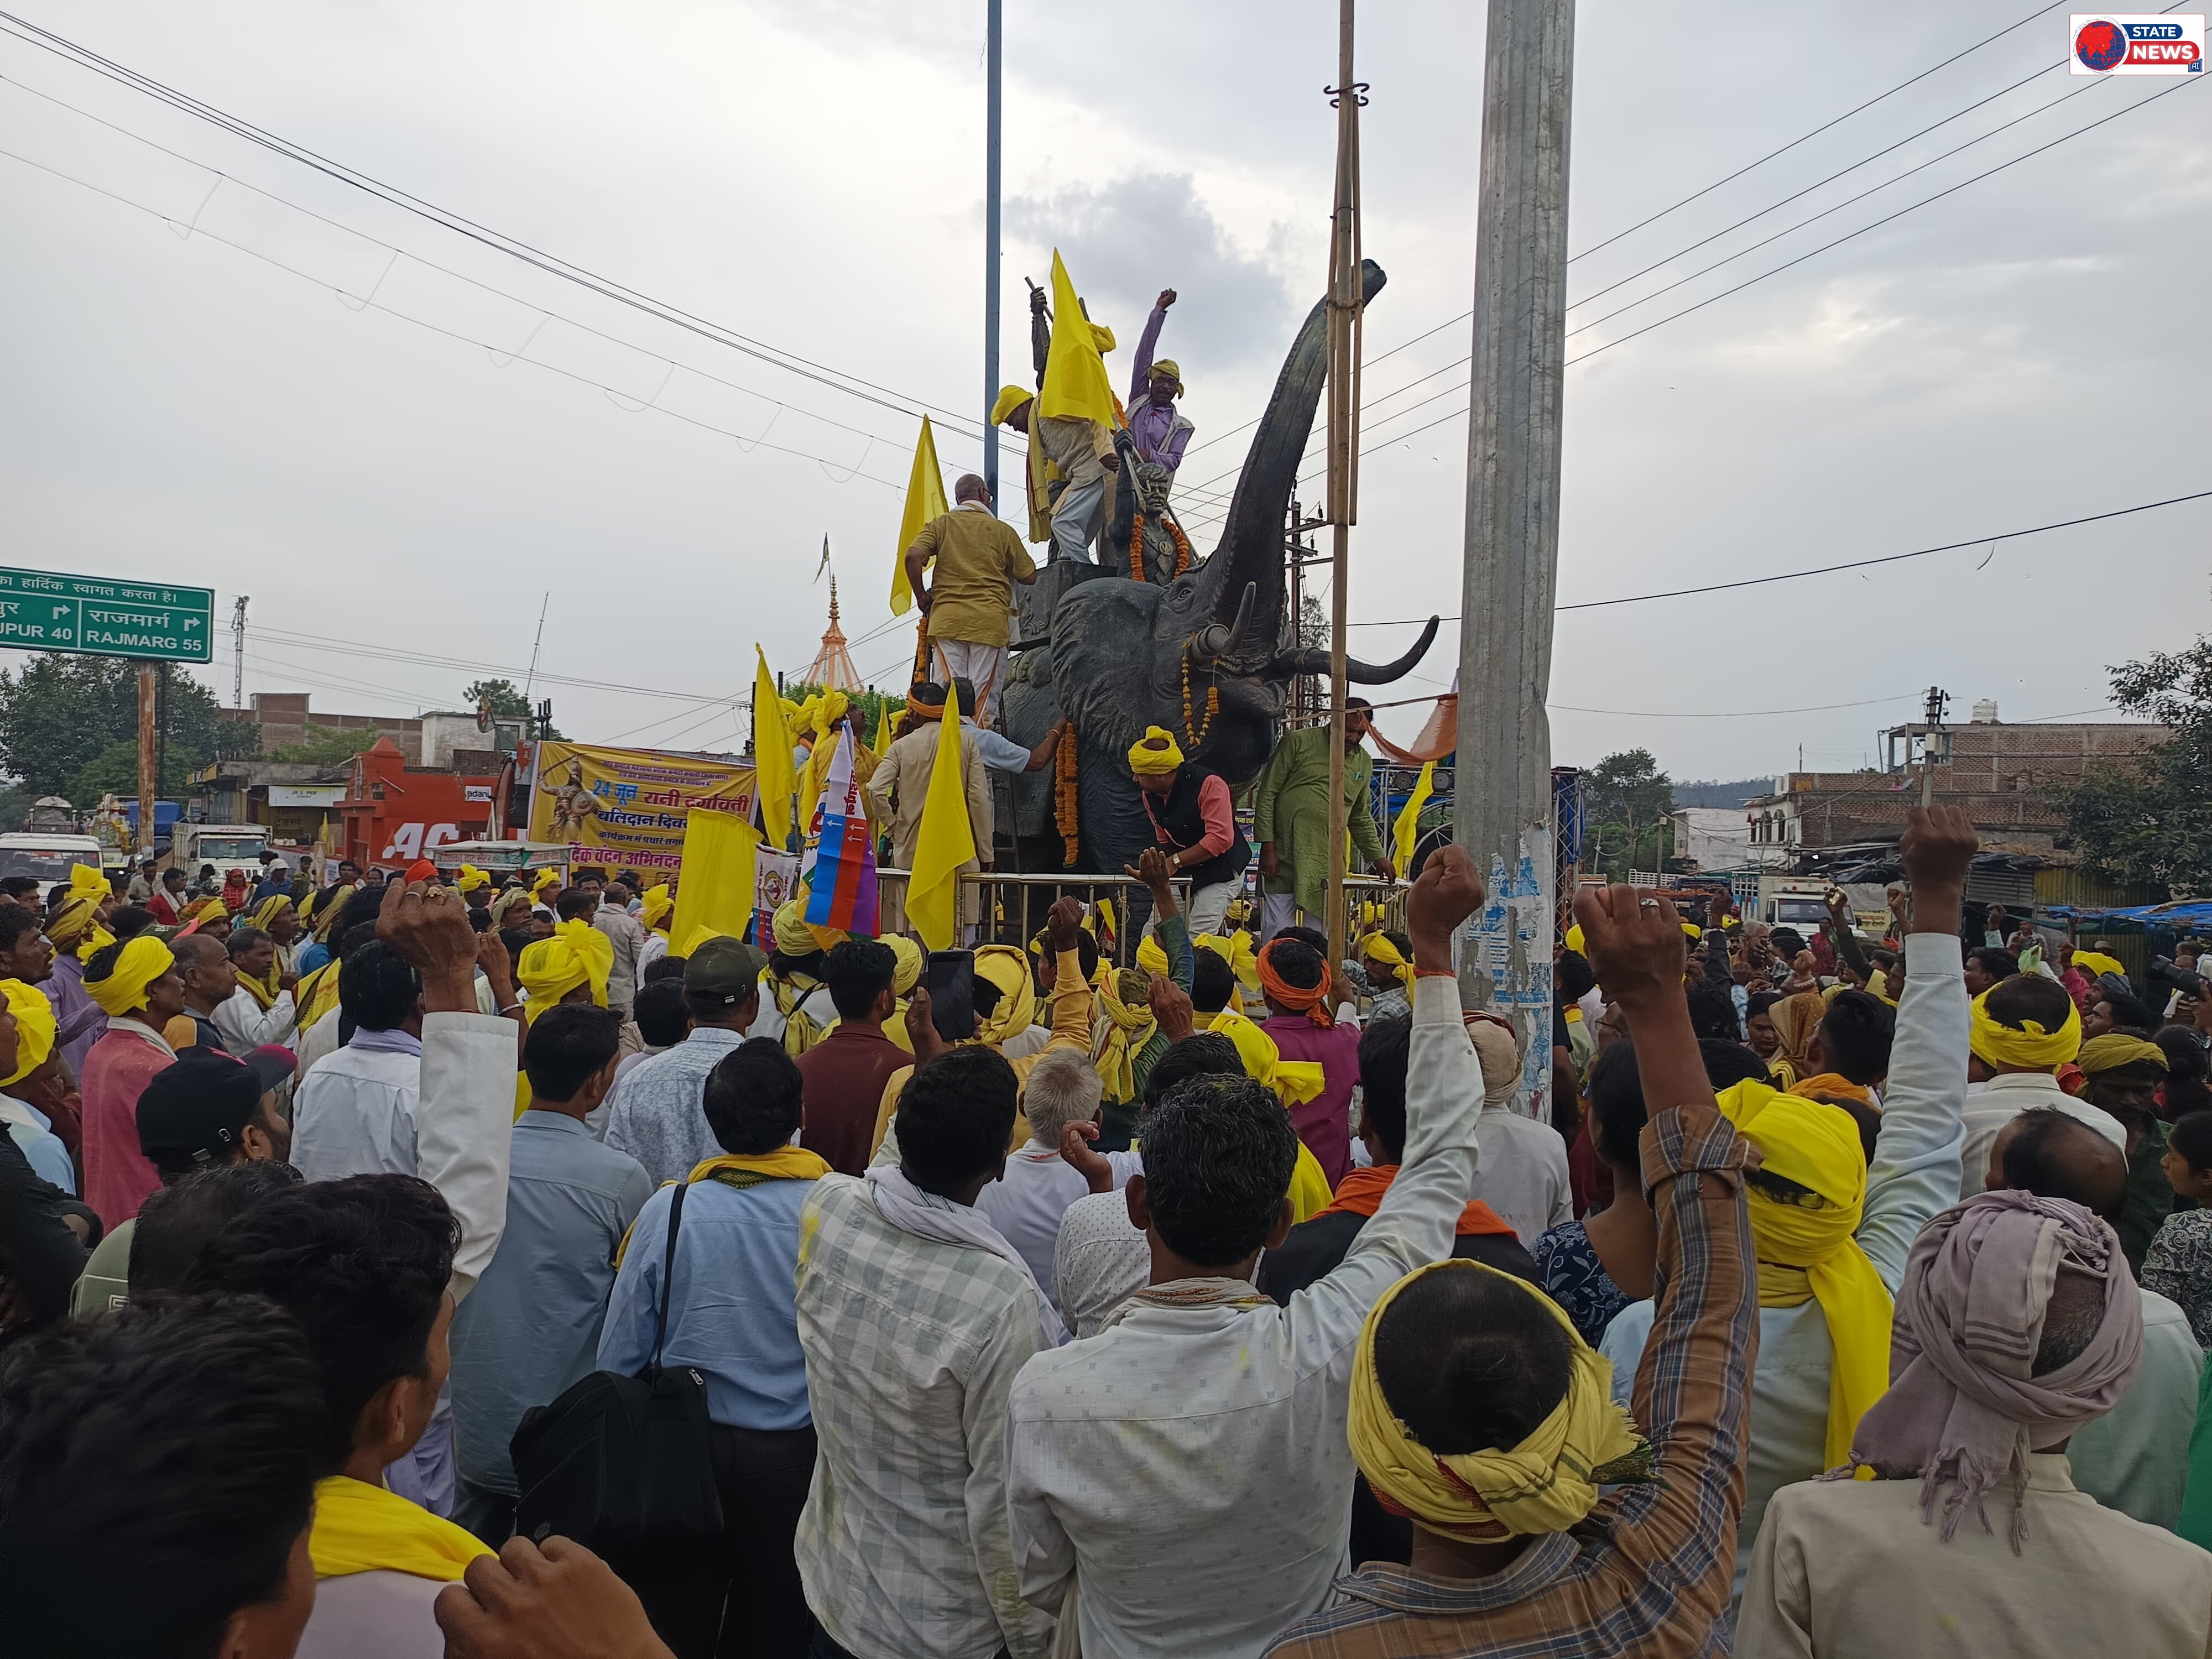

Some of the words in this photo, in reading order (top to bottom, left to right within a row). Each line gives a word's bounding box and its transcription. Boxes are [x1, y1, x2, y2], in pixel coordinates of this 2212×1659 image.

[21, 577, 65, 591] हार्दिक
[72, 583, 114, 596] स्वागत
[121, 588, 156, 601] करता
[88, 610, 170, 628] राजमार्ग
[51, 628, 72, 640] 40
[87, 630, 178, 649] RAJMARG
[182, 639, 202, 651] 55
[467, 790, 489, 799] adani
[593, 779, 611, 797] 24
[614, 782, 639, 805] जून
[643, 789, 681, 807] रानी
[598, 807, 655, 826] बलिदान
[599, 831, 633, 842] कार्यक्रम
[634, 834, 643, 842] में
[594, 844, 624, 864] वंदन
[625, 849, 682, 870] अभिनंदन
